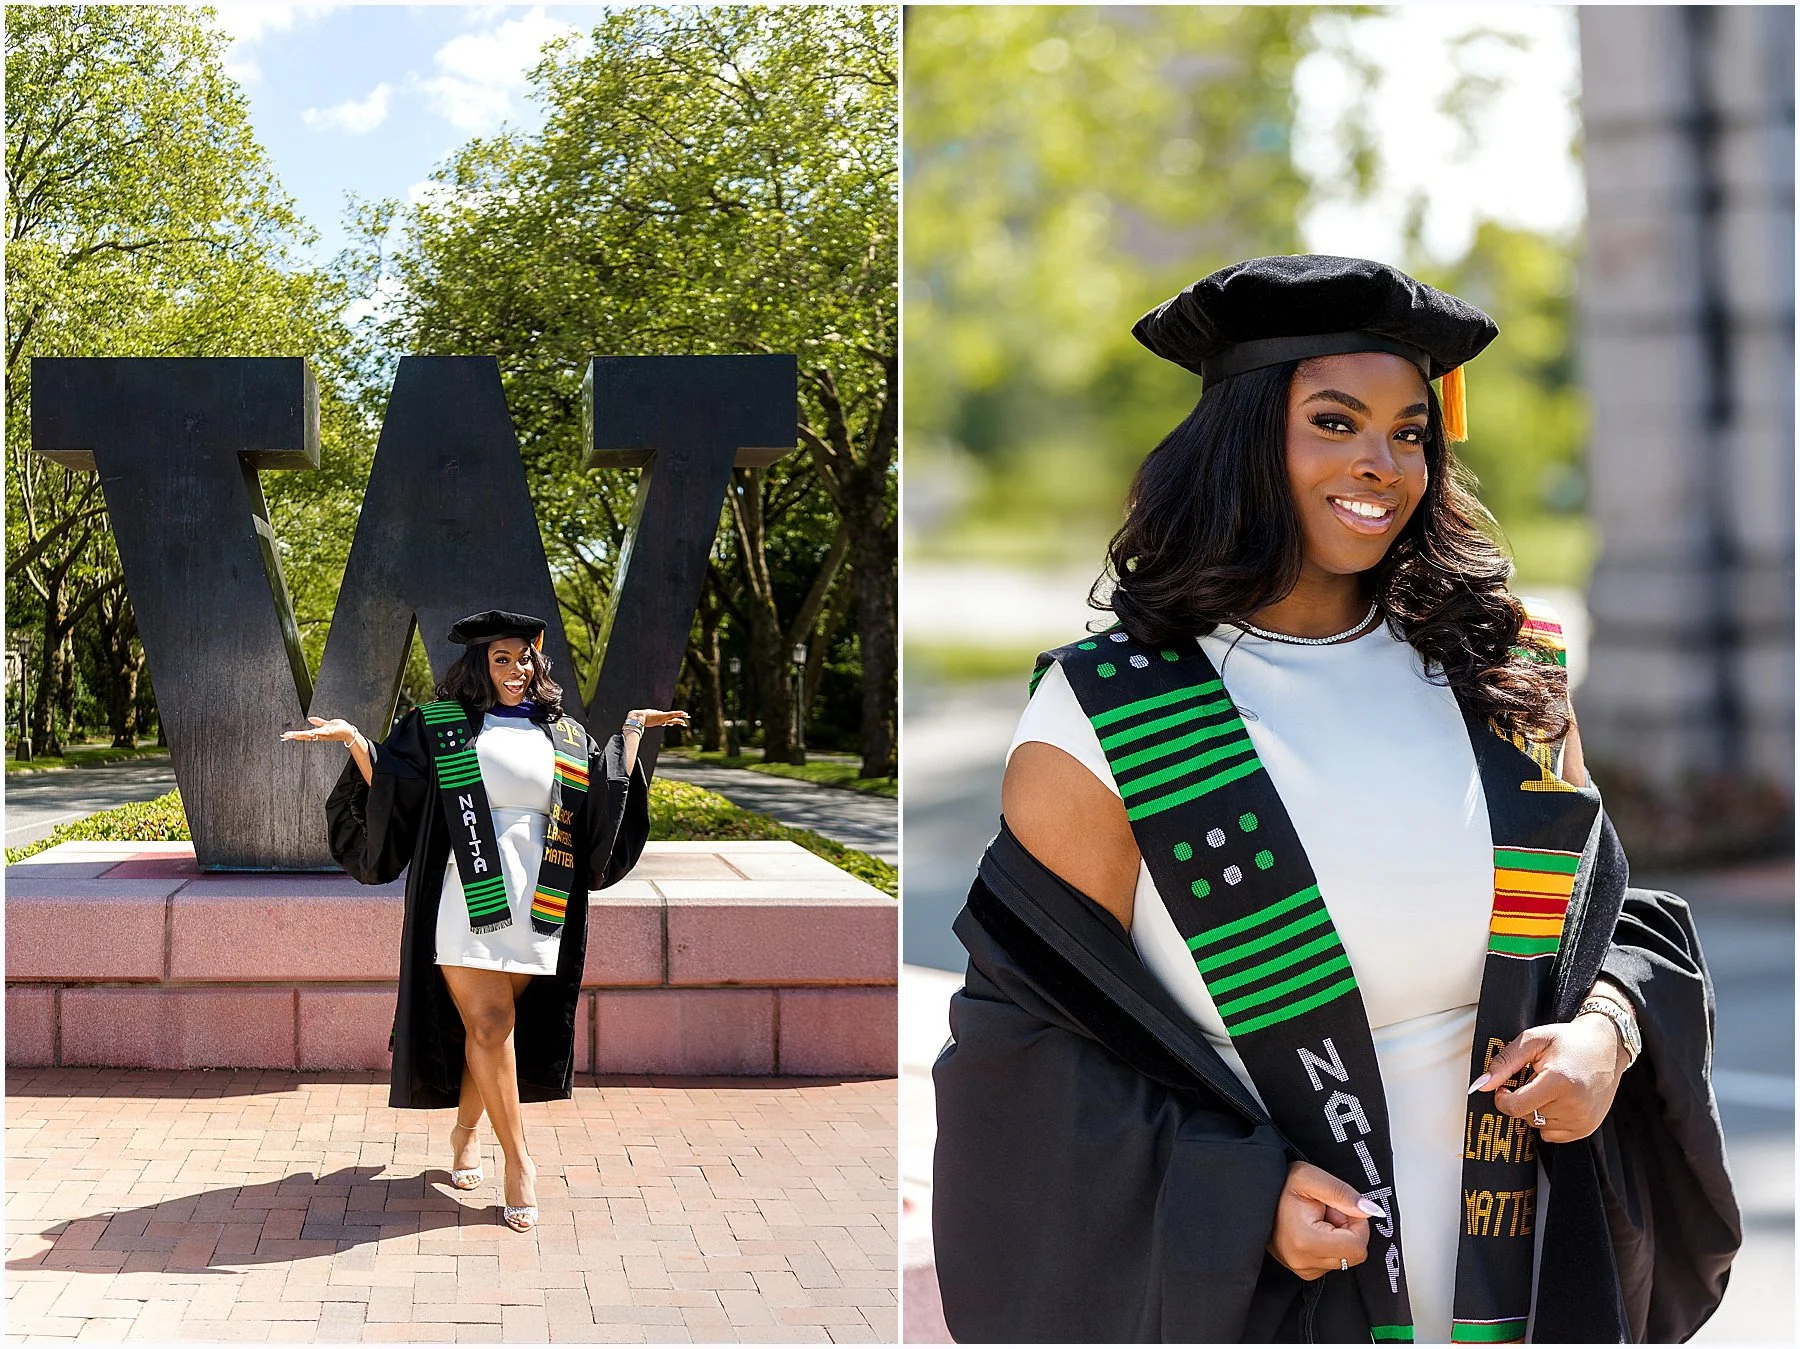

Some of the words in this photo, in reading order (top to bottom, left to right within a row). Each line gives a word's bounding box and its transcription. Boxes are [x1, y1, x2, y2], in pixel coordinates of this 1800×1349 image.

[31, 355, 798, 873] W
[458, 793, 488, 874] NAIJA
[544, 846, 574, 869] MATTER
[1465, 1111, 1535, 1164] LAWYE
[1464, 1188, 1536, 1237] MATTE
